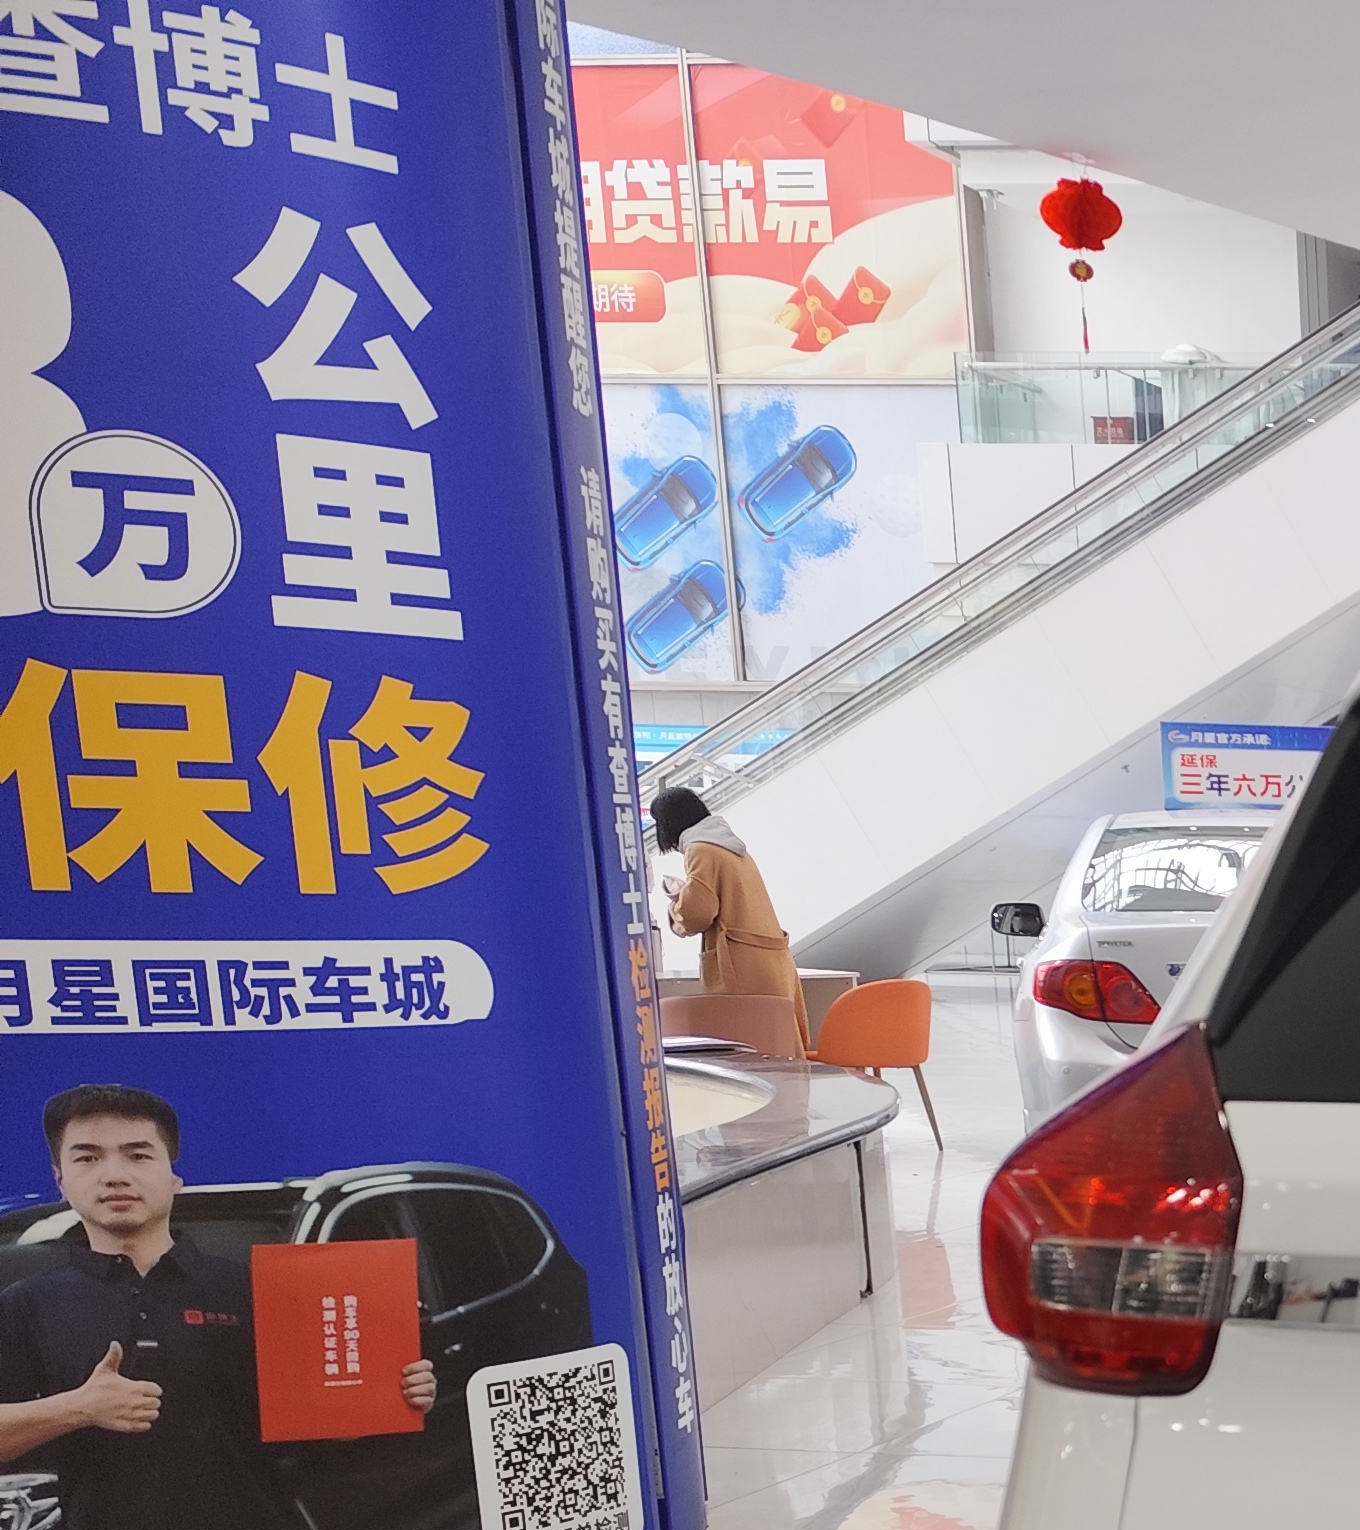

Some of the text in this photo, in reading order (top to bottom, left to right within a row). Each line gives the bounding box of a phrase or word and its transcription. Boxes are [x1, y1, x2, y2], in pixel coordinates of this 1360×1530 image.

[232, 205, 465, 642] 公里
[70, 469, 196, 582] 万
[0, 657, 491, 896] 保修
[1179, 753, 1218, 769] 延保
